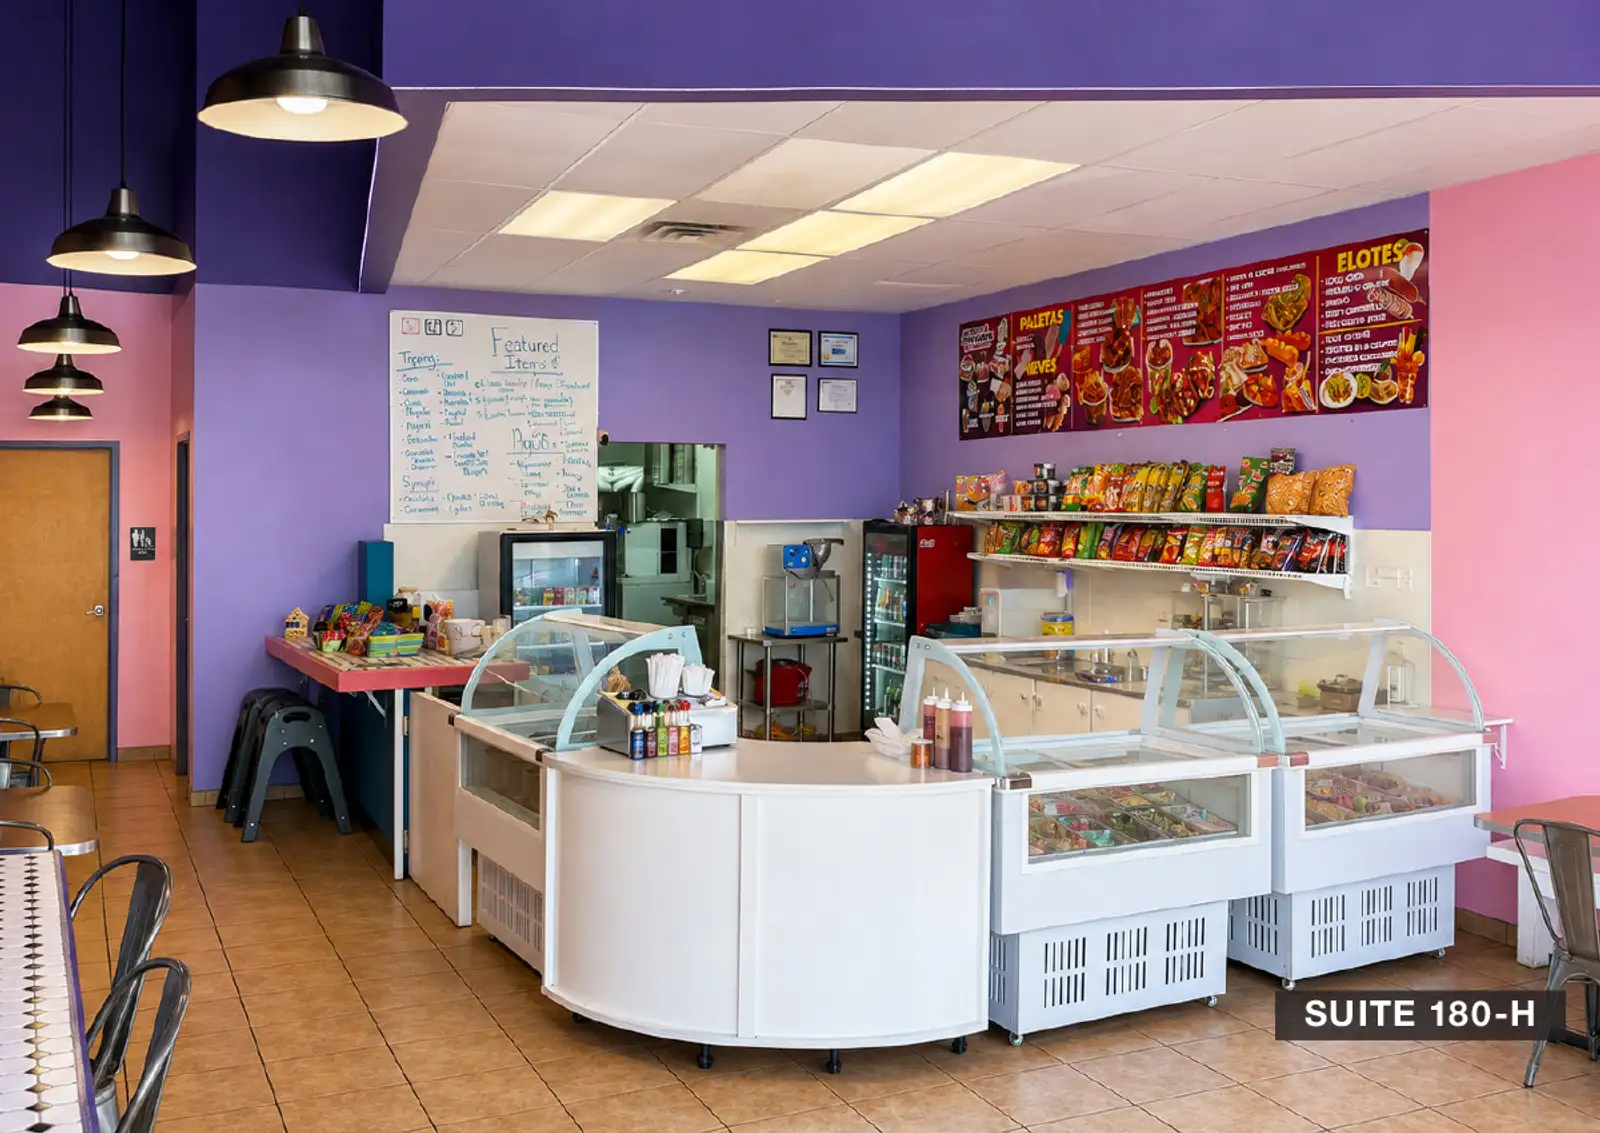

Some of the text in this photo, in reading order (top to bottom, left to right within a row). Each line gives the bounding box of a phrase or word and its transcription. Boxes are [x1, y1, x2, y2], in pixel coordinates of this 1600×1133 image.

[1337, 242, 1404, 273] ELOTES
[1020, 309, 1064, 331] PALETAS
[491, 327, 559, 357] Featured
[504, 354, 547, 370] Items
